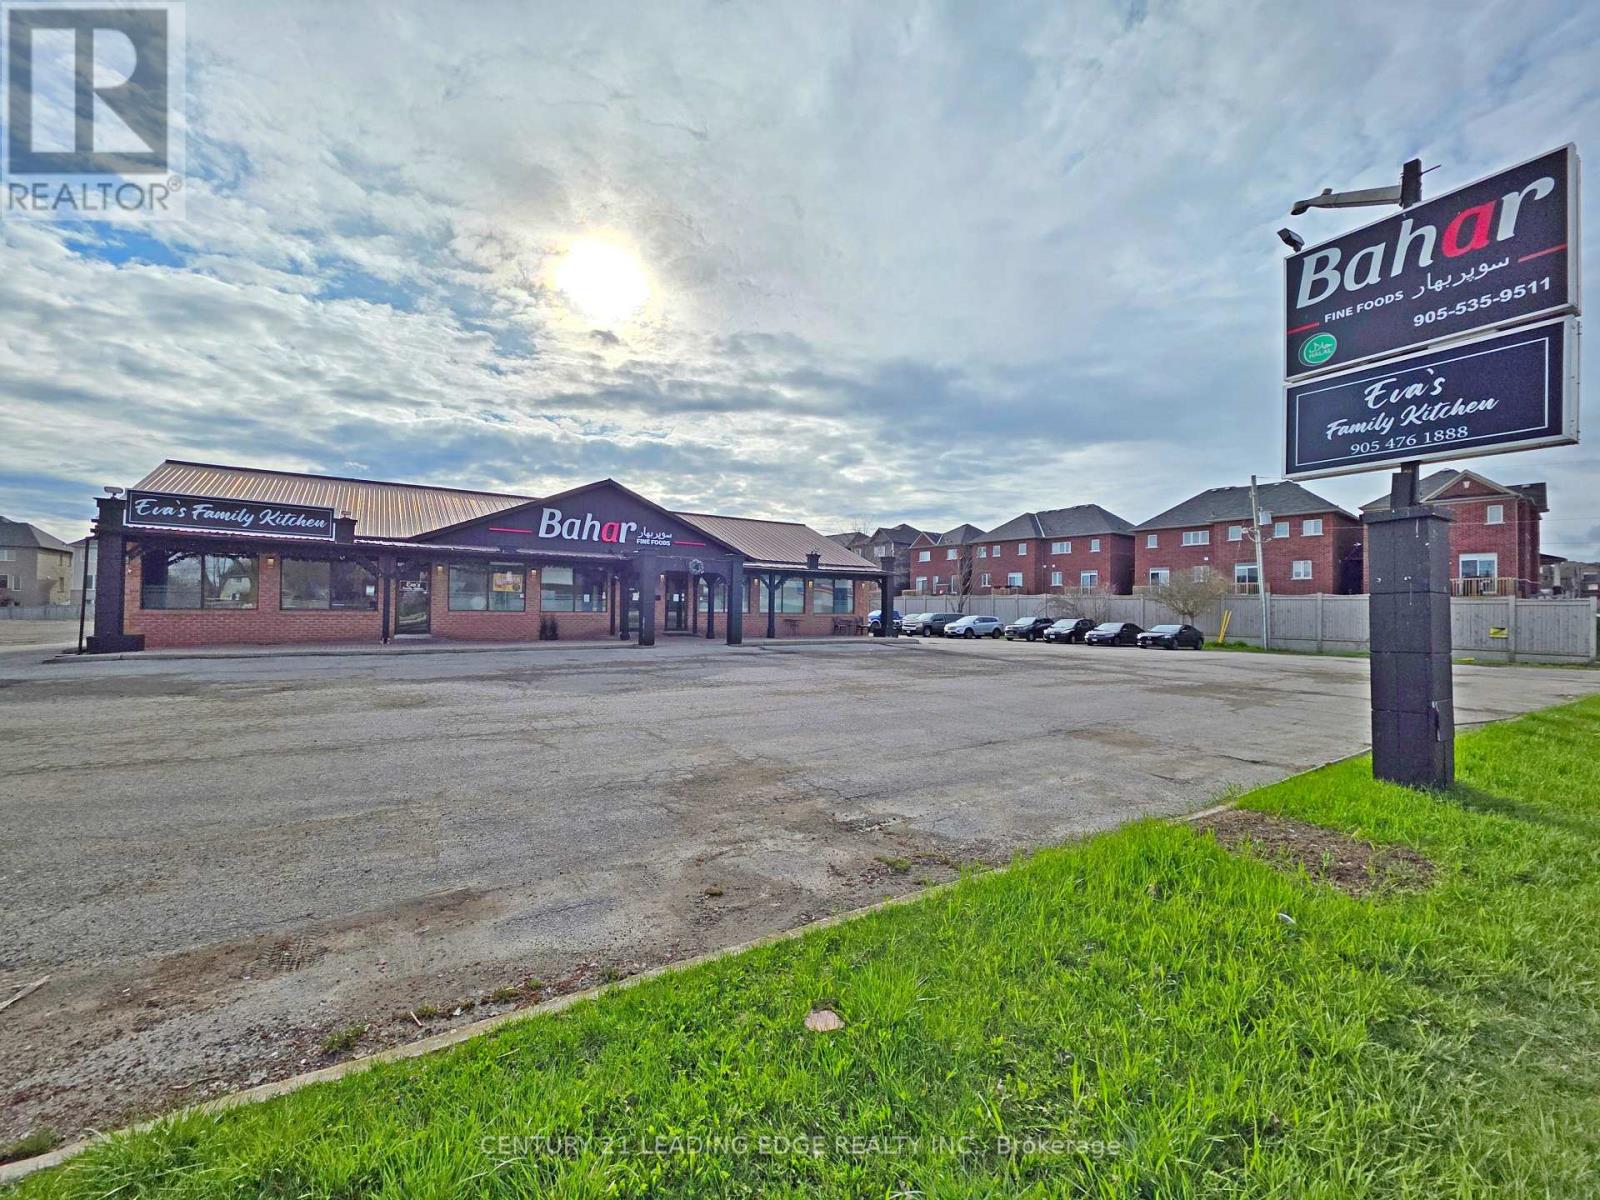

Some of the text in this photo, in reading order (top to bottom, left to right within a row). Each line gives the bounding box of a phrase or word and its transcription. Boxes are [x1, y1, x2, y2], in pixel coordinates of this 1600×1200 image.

[1296, 176, 1555, 310] Bahar
[1324, 291, 1404, 324] FINE FOODS
[1413, 277, 1550, 327] 905-535-9511
[1364, 368, 1446, 410] Eva's
[1326, 398, 1499, 441] Family Kitchen
[1351, 426, 1468, 455] 905 476 1888
[134, 498, 327, 529] Eva's Family Kitchen
[538, 507, 638, 544] Bahar
[651, 539, 671, 547] FOODS
